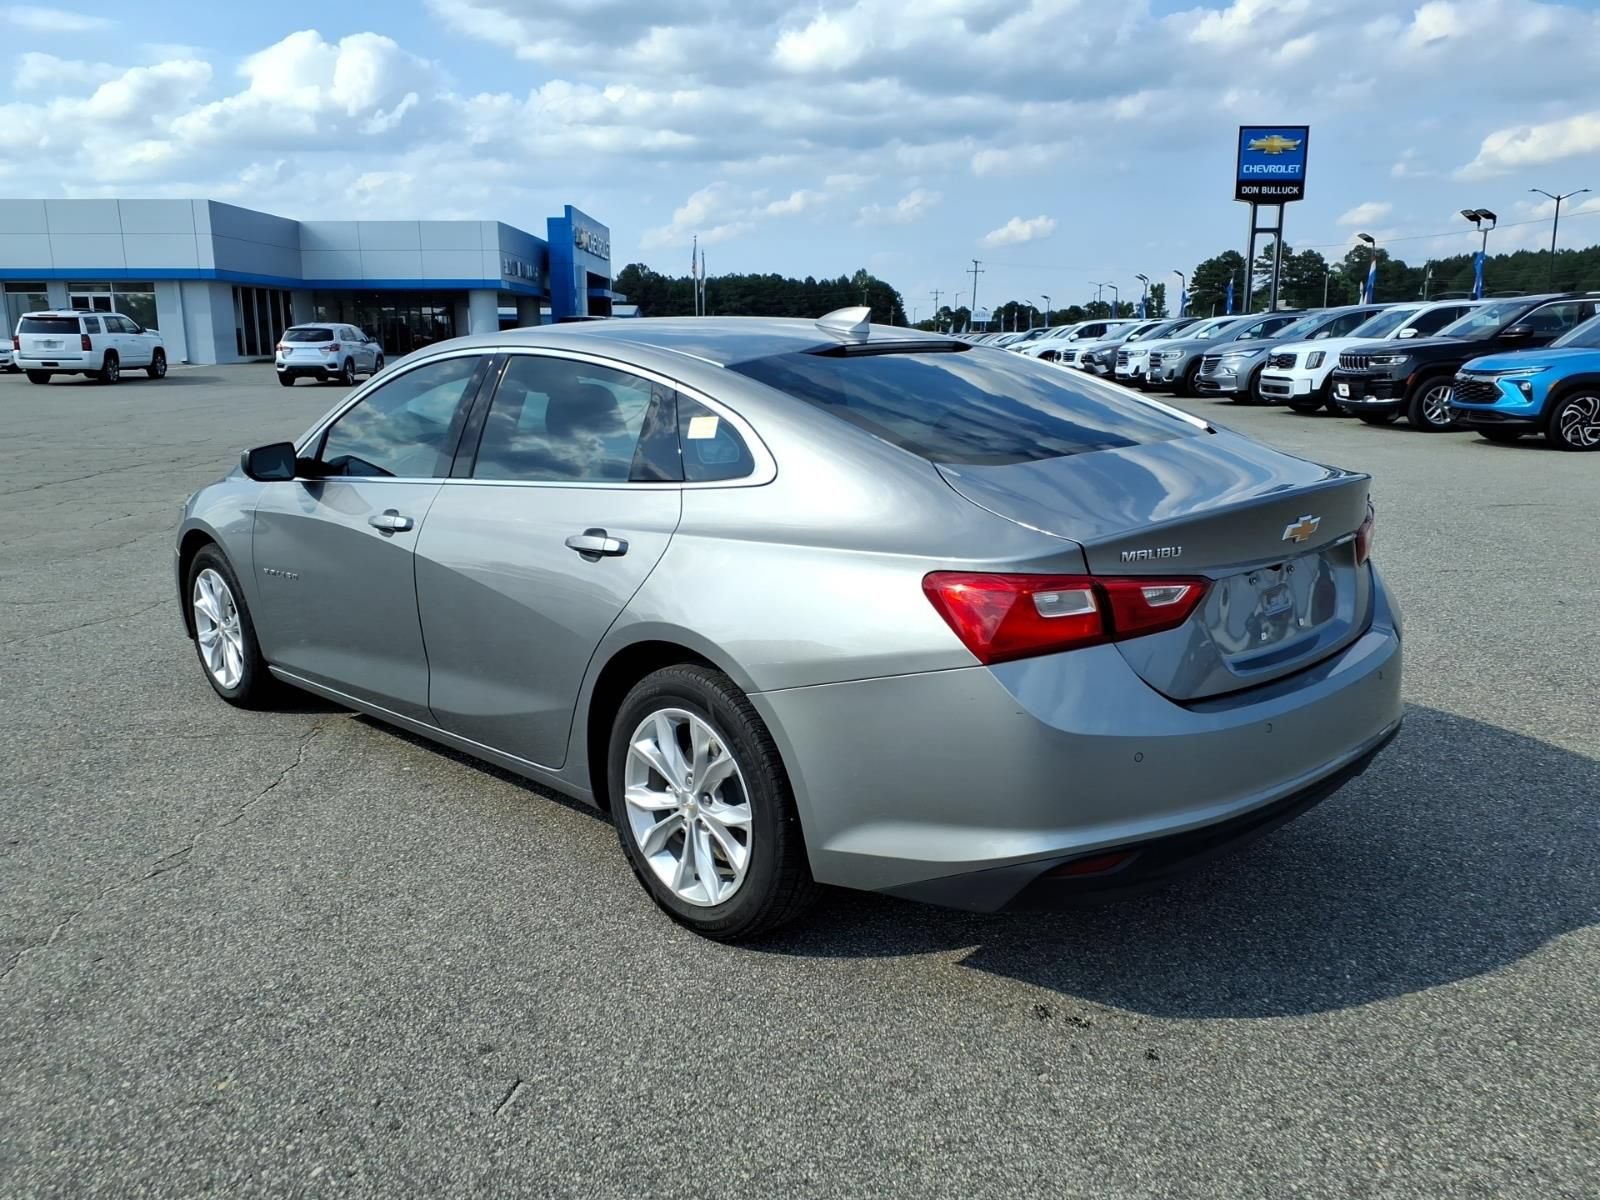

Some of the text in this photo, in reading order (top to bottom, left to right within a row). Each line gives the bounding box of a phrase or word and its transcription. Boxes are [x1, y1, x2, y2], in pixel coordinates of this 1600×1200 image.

[1243, 164, 1301, 174] CHEVROLET
[1241, 186, 1300, 195] DON BULLUCK
[1121, 546, 1182, 562] MALIBU
